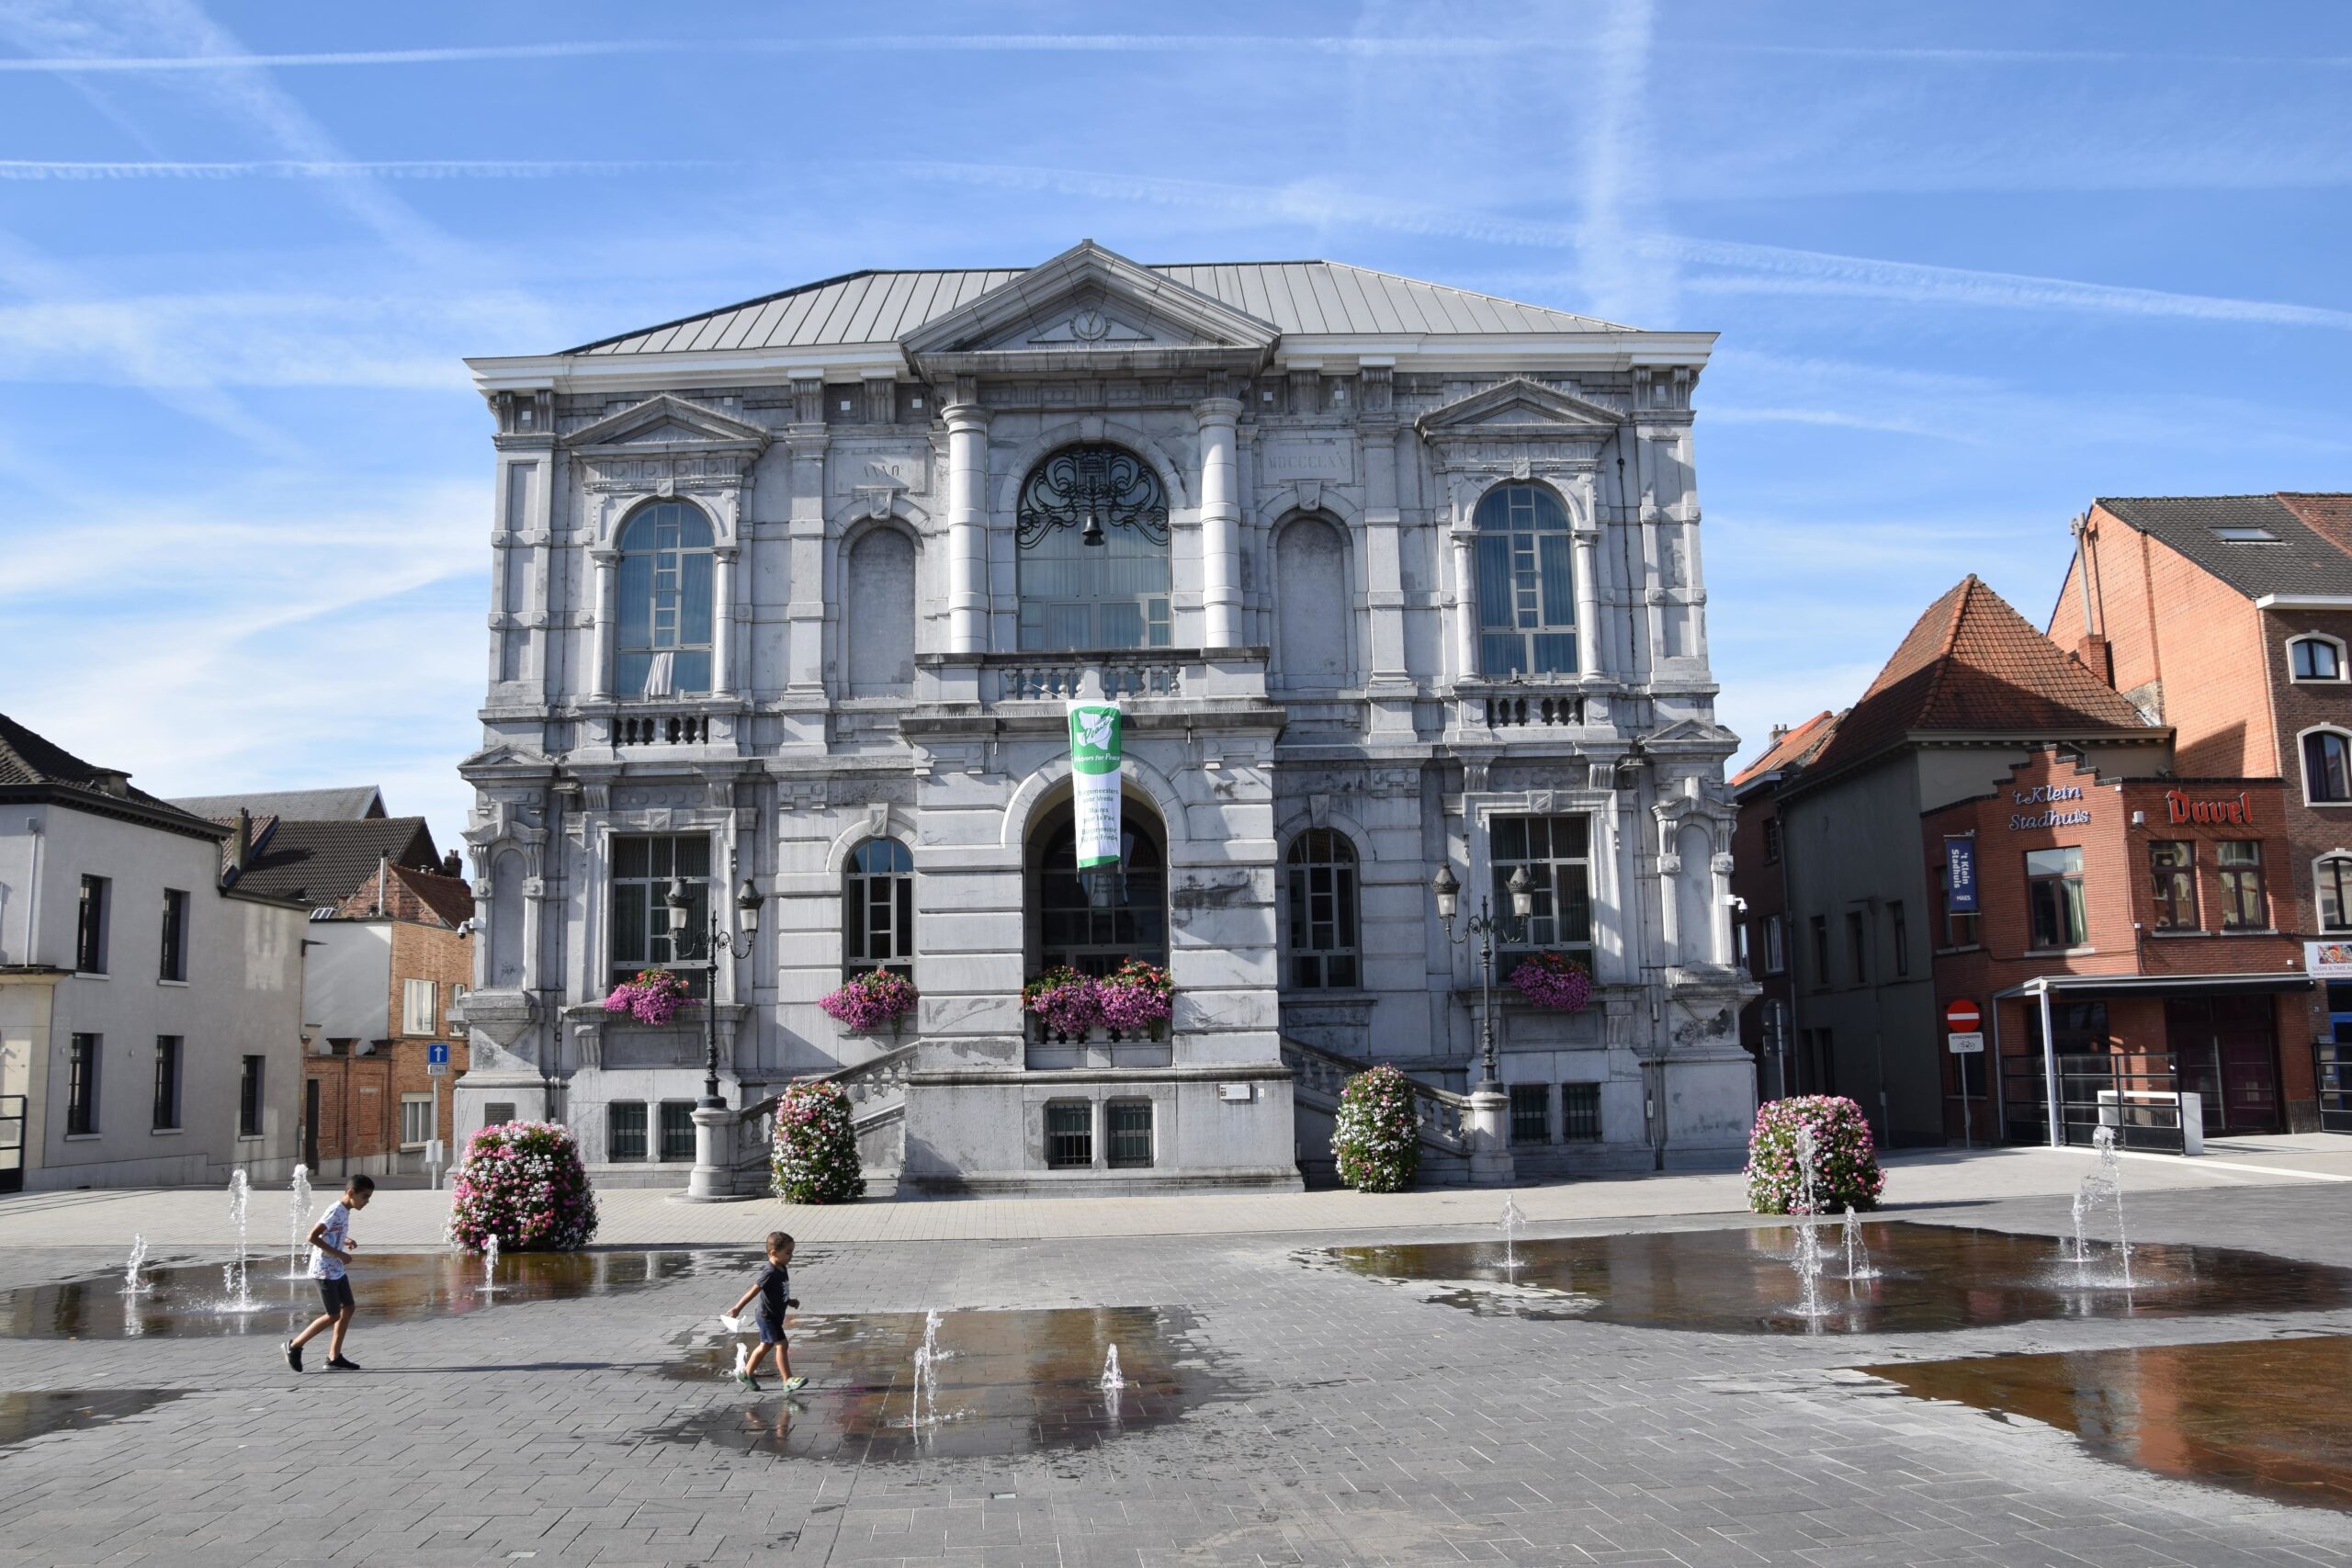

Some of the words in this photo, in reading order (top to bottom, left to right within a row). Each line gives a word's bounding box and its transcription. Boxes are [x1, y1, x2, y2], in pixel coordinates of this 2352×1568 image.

[1105, 752, 1120, 761] Peace
[2023, 784, 2081, 805] Klein
[2165, 790, 2253, 823] Duvel
[2008, 808, 2089, 831] Stadhuis
[1951, 849, 1962, 888] Stadhuis
[1962, 862, 1971, 885] Klein
